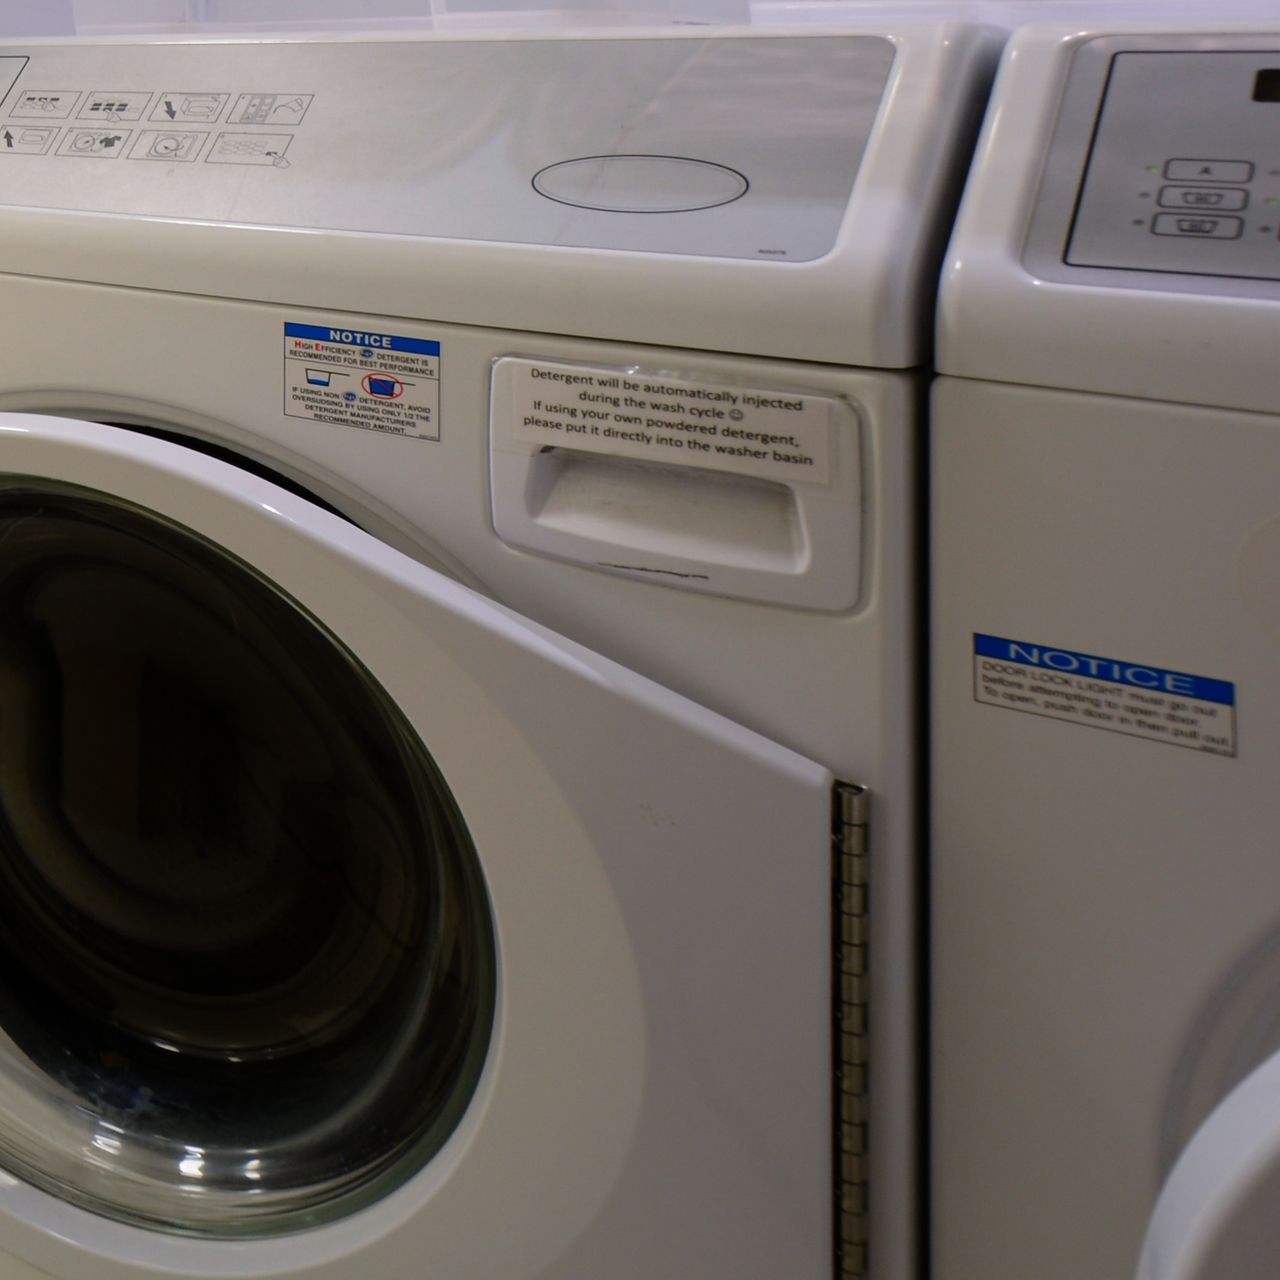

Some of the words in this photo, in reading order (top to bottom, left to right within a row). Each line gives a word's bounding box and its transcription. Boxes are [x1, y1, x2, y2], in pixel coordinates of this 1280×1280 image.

[330, 330, 392, 348] NOTICE
[290, 350, 341, 362] RECOMMENDED
[360, 360, 377, 368] BEST
[379, 363, 434, 376] PERFORMANCE
[315, 344, 356, 356] EFFICIENCY
[377, 353, 420, 365] DETERGENT
[300, 388, 322, 397] USING
[324, 391, 339, 399] NON
[408, 405, 430, 414] AVOID
[531, 368, 593, 385] Detergent
[598, 378, 619, 389] will
[624, 380, 639, 391] be
[644, 384, 738, 405] automatically
[742, 394, 803, 411] injected
[293, 395, 341, 409] OVERSUDSING
[357, 405, 380, 414] USING
[382, 408, 401, 417] ONLY
[416, 414, 430, 422] THE
[305, 404, 348, 416] DETERGENT
[350, 412, 416, 428] MANUFACTURERS
[579, 391, 620, 407] during
[624, 397, 646, 409] the
[650, 401, 685, 414] wash
[689, 406, 725, 419] cycle
[314, 413, 371, 428] RECOMMENDED
[373, 423, 406, 434] AMOUNT.
[534, 400, 542, 410] If
[546, 404, 577, 417] using
[581, 410, 610, 420] your
[614, 413, 642, 425] own
[646, 418, 718, 436] powdered
[721, 426, 799, 448] detergent,
[524, 416, 562, 430] please
[566, 423, 587, 434] put
[591, 425, 599, 436] it
[603, 427, 652, 445] directly
[656, 435, 684, 448] into
[688, 439, 710, 452] the
[715, 445, 768, 459] washer
[773, 450, 814, 466] basin
[982, 661, 1027, 677] DOOR
[1031, 670, 1072, 686] LOCK
[1009, 643, 1196, 695] NOTICE
